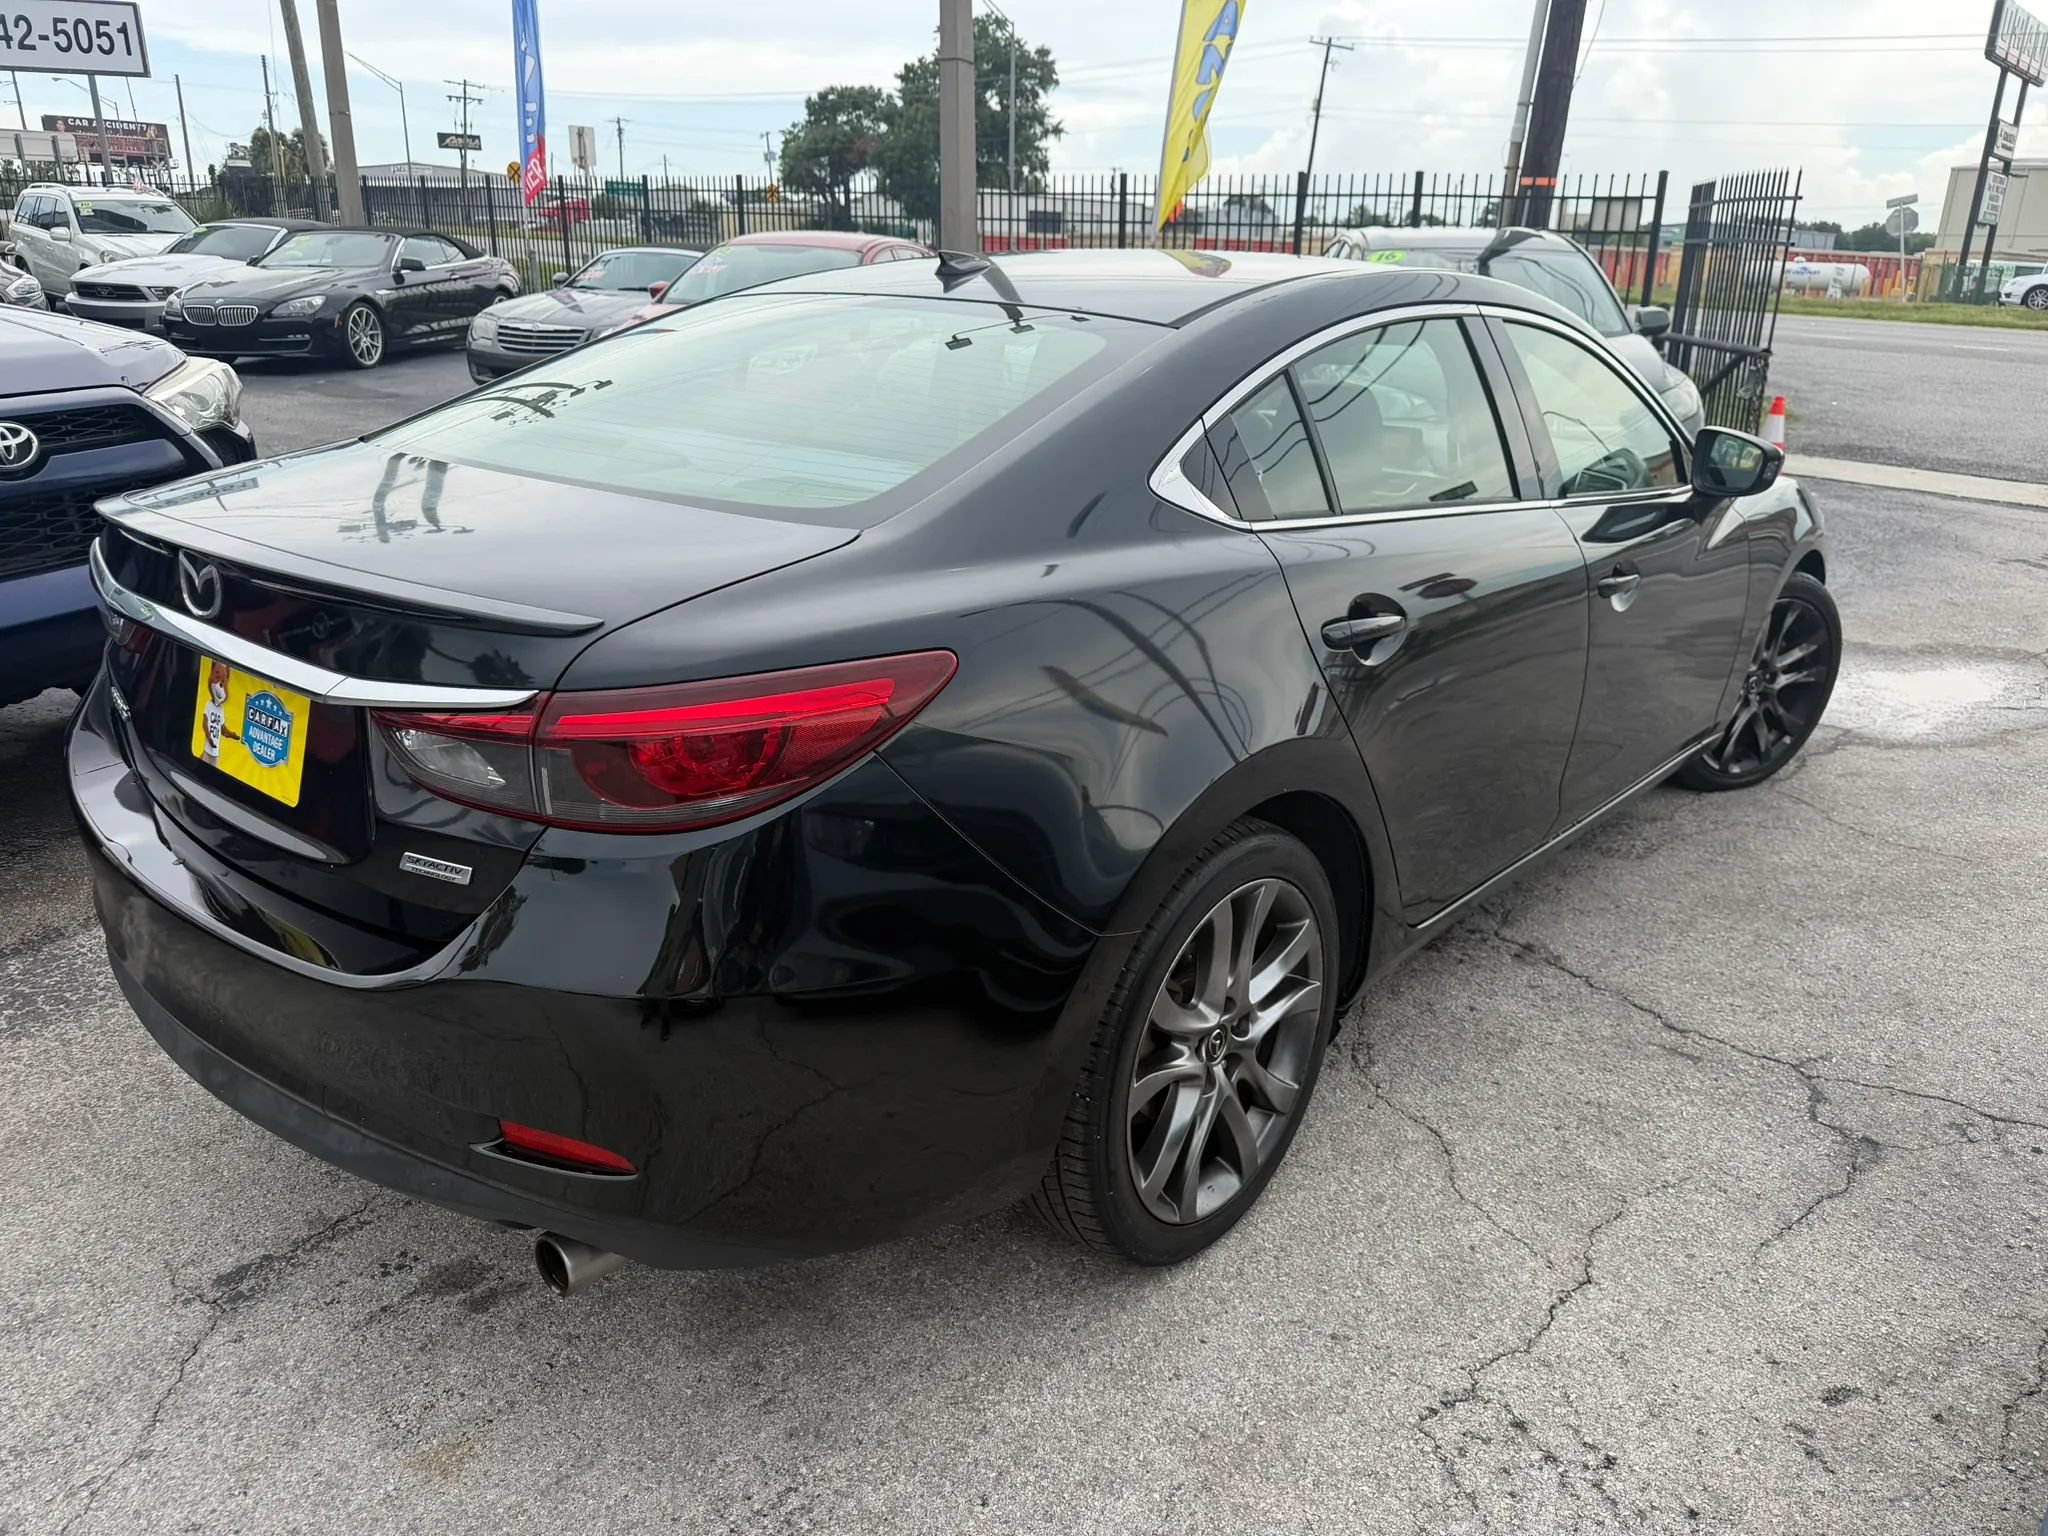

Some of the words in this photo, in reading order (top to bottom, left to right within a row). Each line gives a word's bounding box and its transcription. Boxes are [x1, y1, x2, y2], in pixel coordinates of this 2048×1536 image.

[68, 118, 89, 127] CAR
[93, 120, 147, 131] ACIDENT?
[210, 711, 221, 726] CAR
[247, 708, 289, 735] CARFAX
[248, 726, 284, 751] ADVANTAGE
[252, 742, 276, 762] DEALER
[406, 856, 463, 875] SKYACTIV
[411, 867, 457, 881] TECHNOLOGY
